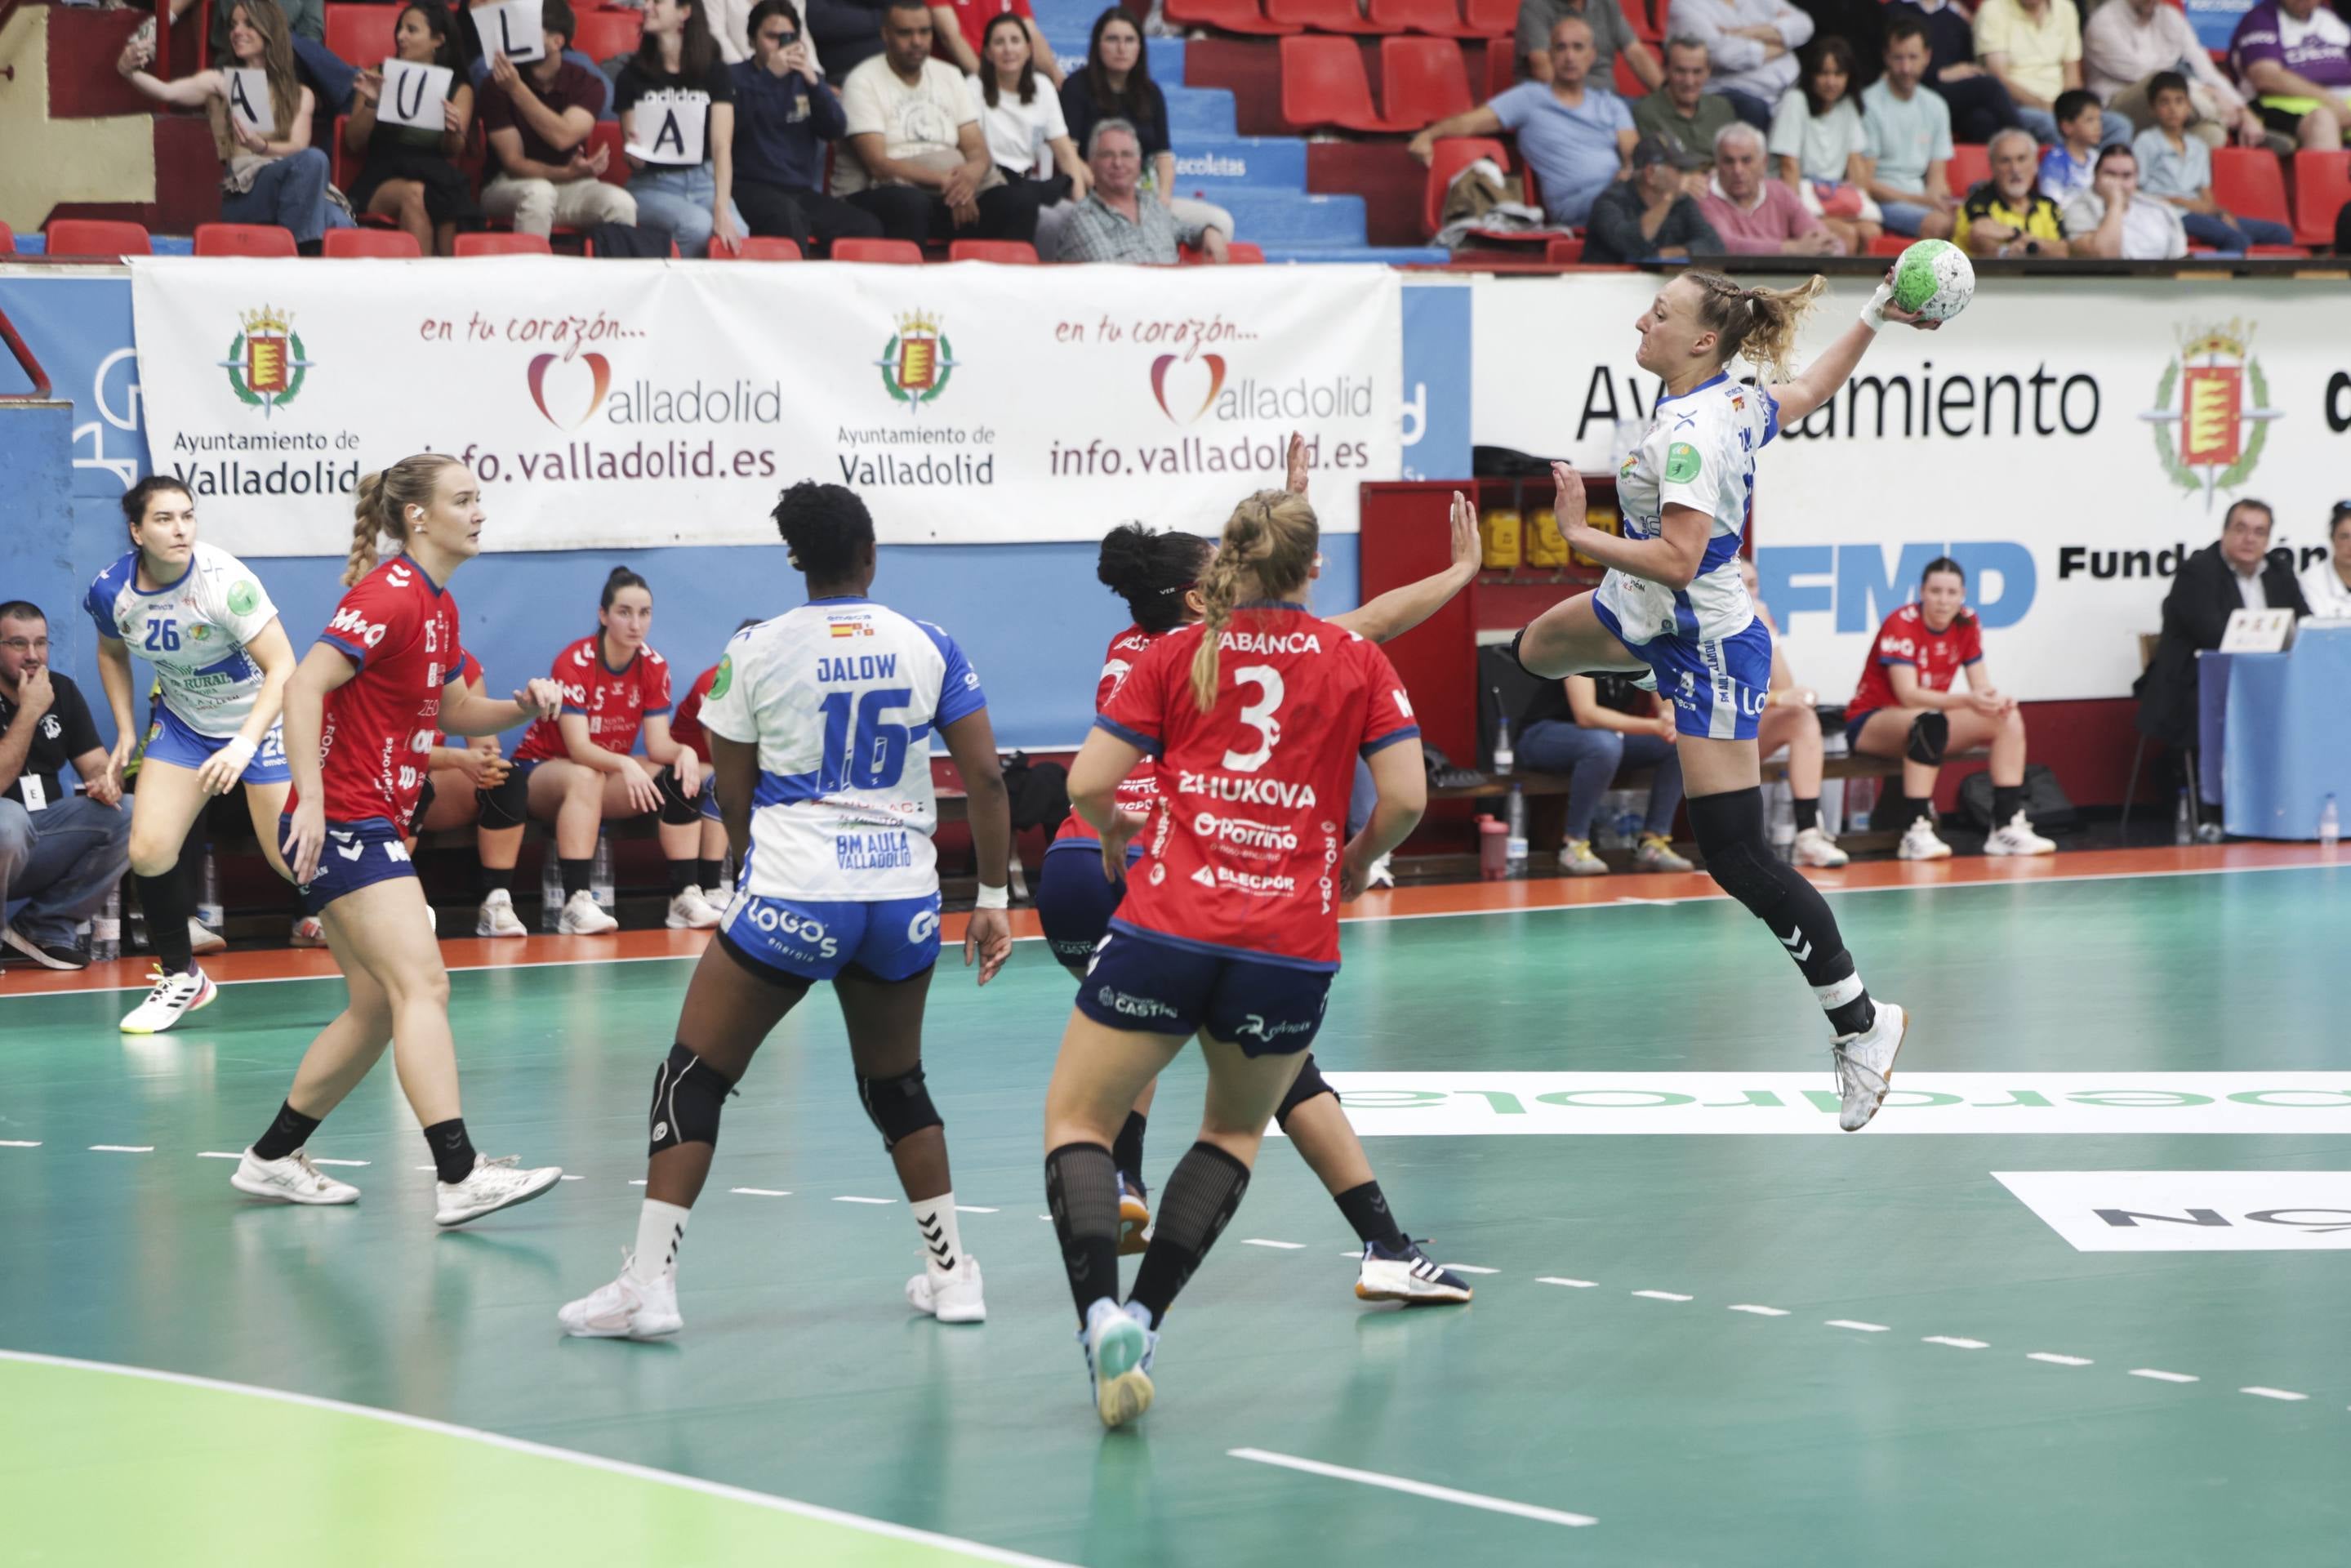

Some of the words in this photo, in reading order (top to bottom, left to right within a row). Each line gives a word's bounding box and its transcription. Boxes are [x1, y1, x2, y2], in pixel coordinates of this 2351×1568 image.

[501, 10, 532, 57] L
[230, 71, 258, 123] A
[398, 70, 427, 121] U
[653, 109, 684, 155] A
[421, 318, 452, 342] en
[468, 312, 496, 341] tu
[1055, 321, 1084, 342] en
[1098, 314, 1121, 341] tu
[1576, 359, 2100, 439] Ayamiento
[173, 431, 327, 455] Ayuntamiento
[336, 430, 360, 450] de
[838, 425, 966, 448] Ayuntamiento
[973, 425, 995, 444] de
[424, 439, 777, 483] fo.valladolid.es
[839, 453, 994, 485] Valladolid
[1050, 433, 1369, 476] info.valladold.es
[172, 461, 359, 496] Valladolid
[1757, 541, 2037, 635] FMD
[145, 619, 180, 652] 26
[425, 619, 437, 653] 15
[1220, 632, 1321, 654] ABANCA
[183, 672, 230, 689] RURAL
[817, 653, 897, 683] JALOW
[1222, 664, 1285, 773] 3
[818, 688, 913, 791] 16
[1178, 769, 1317, 809] ZHUKOVA
[836, 835, 863, 854] BM
[867, 831, 910, 853] AULA
[838, 851, 911, 870] VALLADOLID
[746, 897, 838, 959] LOGOS
